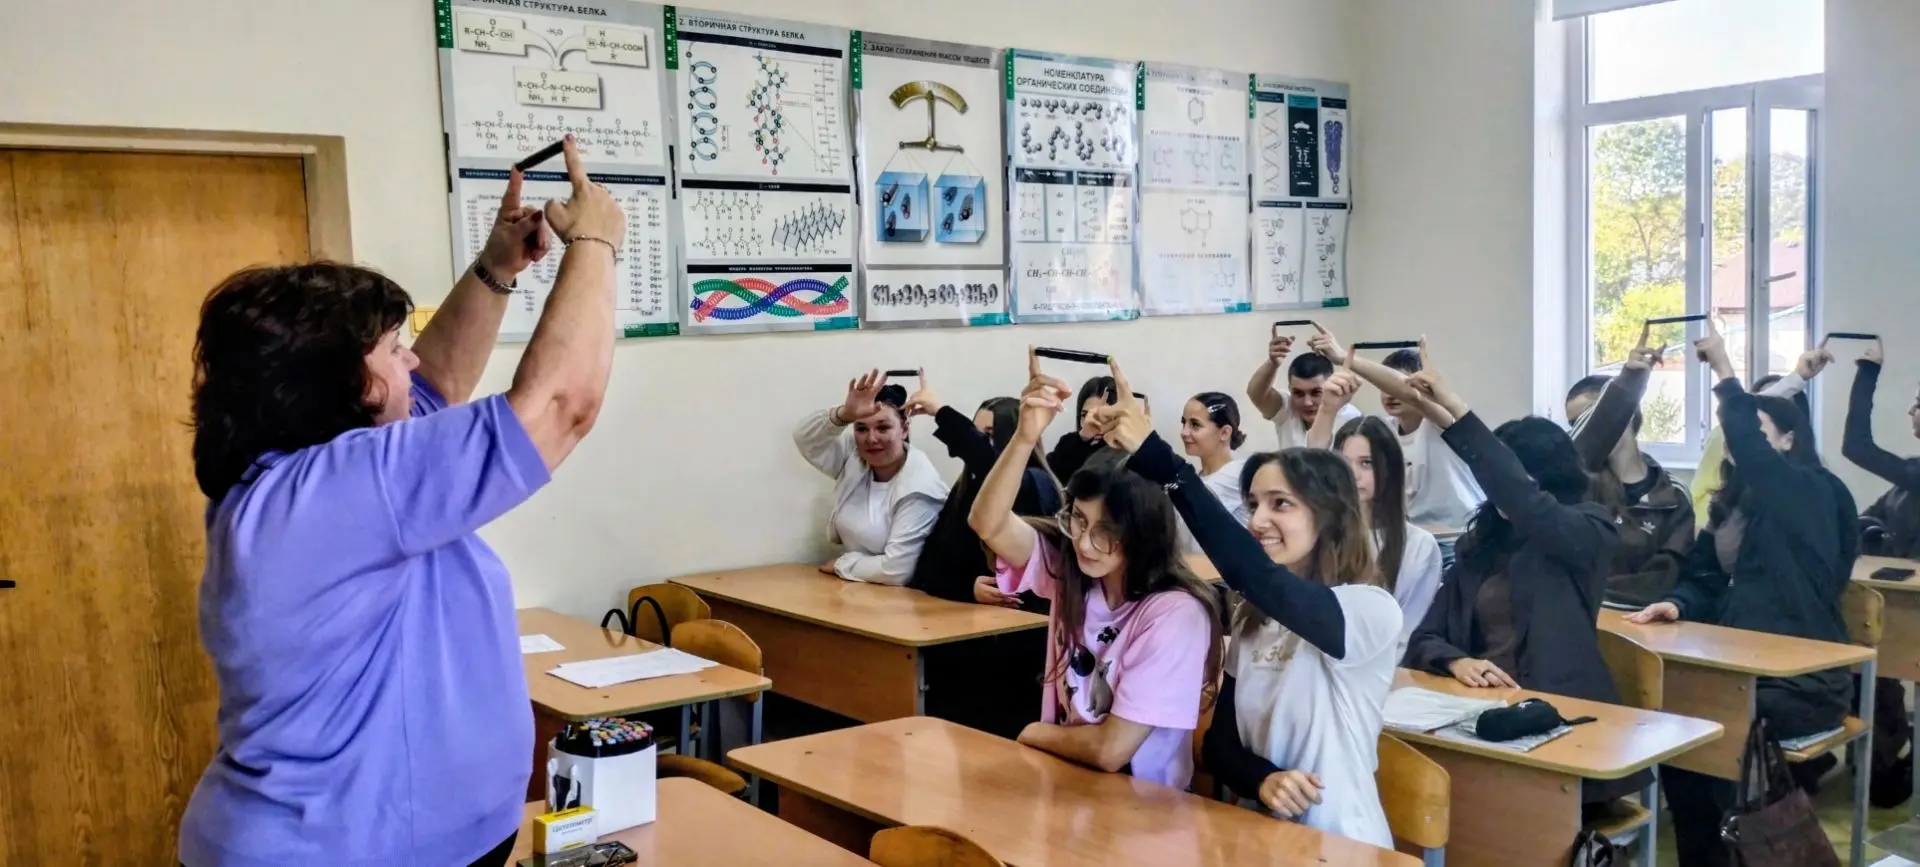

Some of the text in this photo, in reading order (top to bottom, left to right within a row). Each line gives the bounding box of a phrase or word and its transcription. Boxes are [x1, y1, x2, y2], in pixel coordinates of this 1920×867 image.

[523, 0, 575, 14] СТРУКТУРА
[577, 6, 607, 16] БЕЛКА
[688, 19, 737, 32] ВТОРИЧНАЯ
[738, 24, 780, 37] СТРУКТУРА
[781, 30, 805, 40] БЕЛКА
[871, 44, 895, 53] ЗАКОН
[895, 47, 937, 59] СОХРАНЕНИЯ
[1044, 68, 1105, 82] НОМЕНКЛАТУРА
[1016, 77, 1077, 92] ОРГАНИЧЕСКИХ
